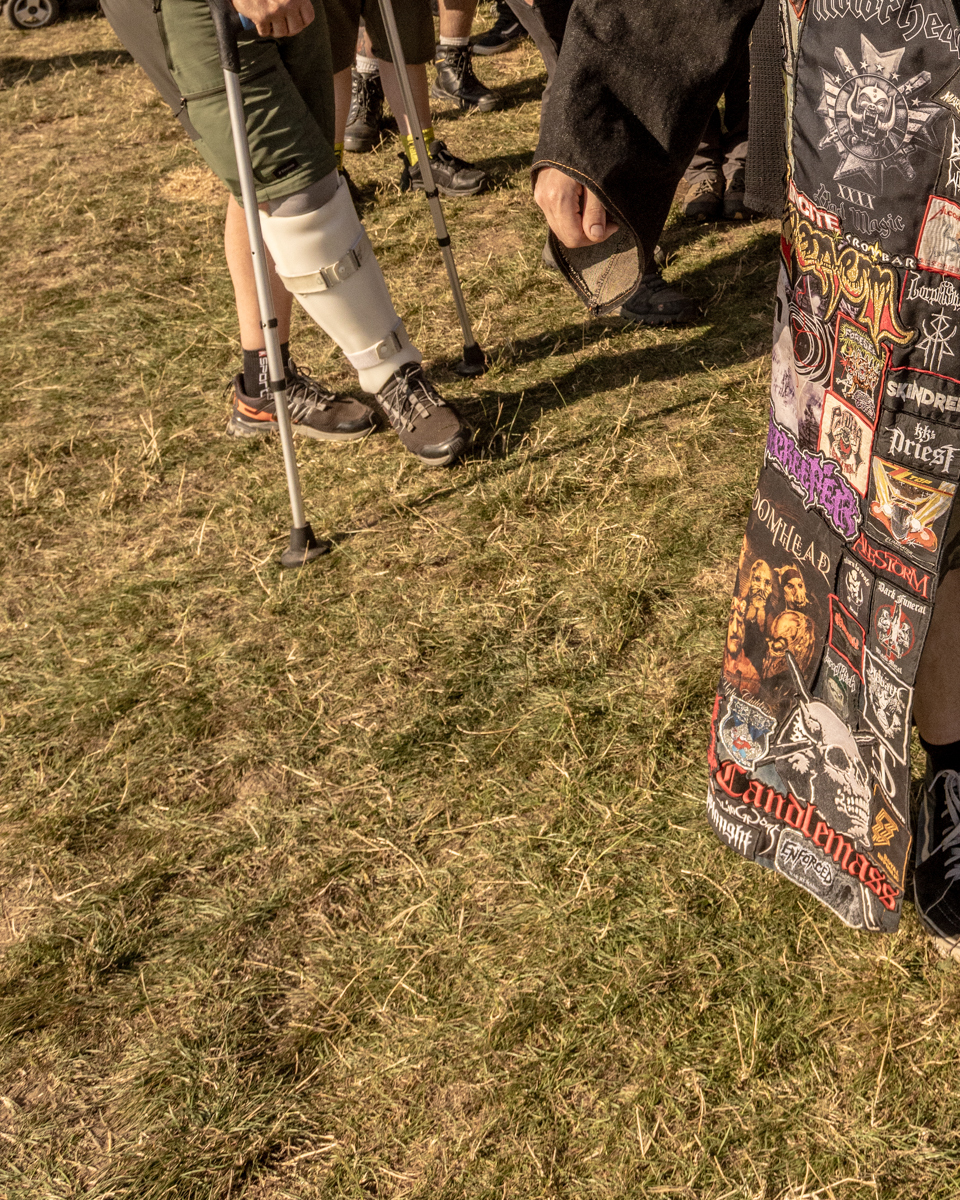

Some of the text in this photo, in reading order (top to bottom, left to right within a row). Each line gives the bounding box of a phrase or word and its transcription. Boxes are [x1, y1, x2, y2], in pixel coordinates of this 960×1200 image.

[788, 179, 841, 235] NCITE
[837, 182, 877, 209] XXXX
[849, 206, 905, 239] Magic
[845, 234, 917, 269] CROWBAR
[909, 475, 933, 485] TOP
[851, 533, 930, 599] ALESTORM
[878, 581, 927, 615] Dark Funeral
[715, 761, 900, 911] Candlemass
[781, 838, 833, 886] ENFORCED
